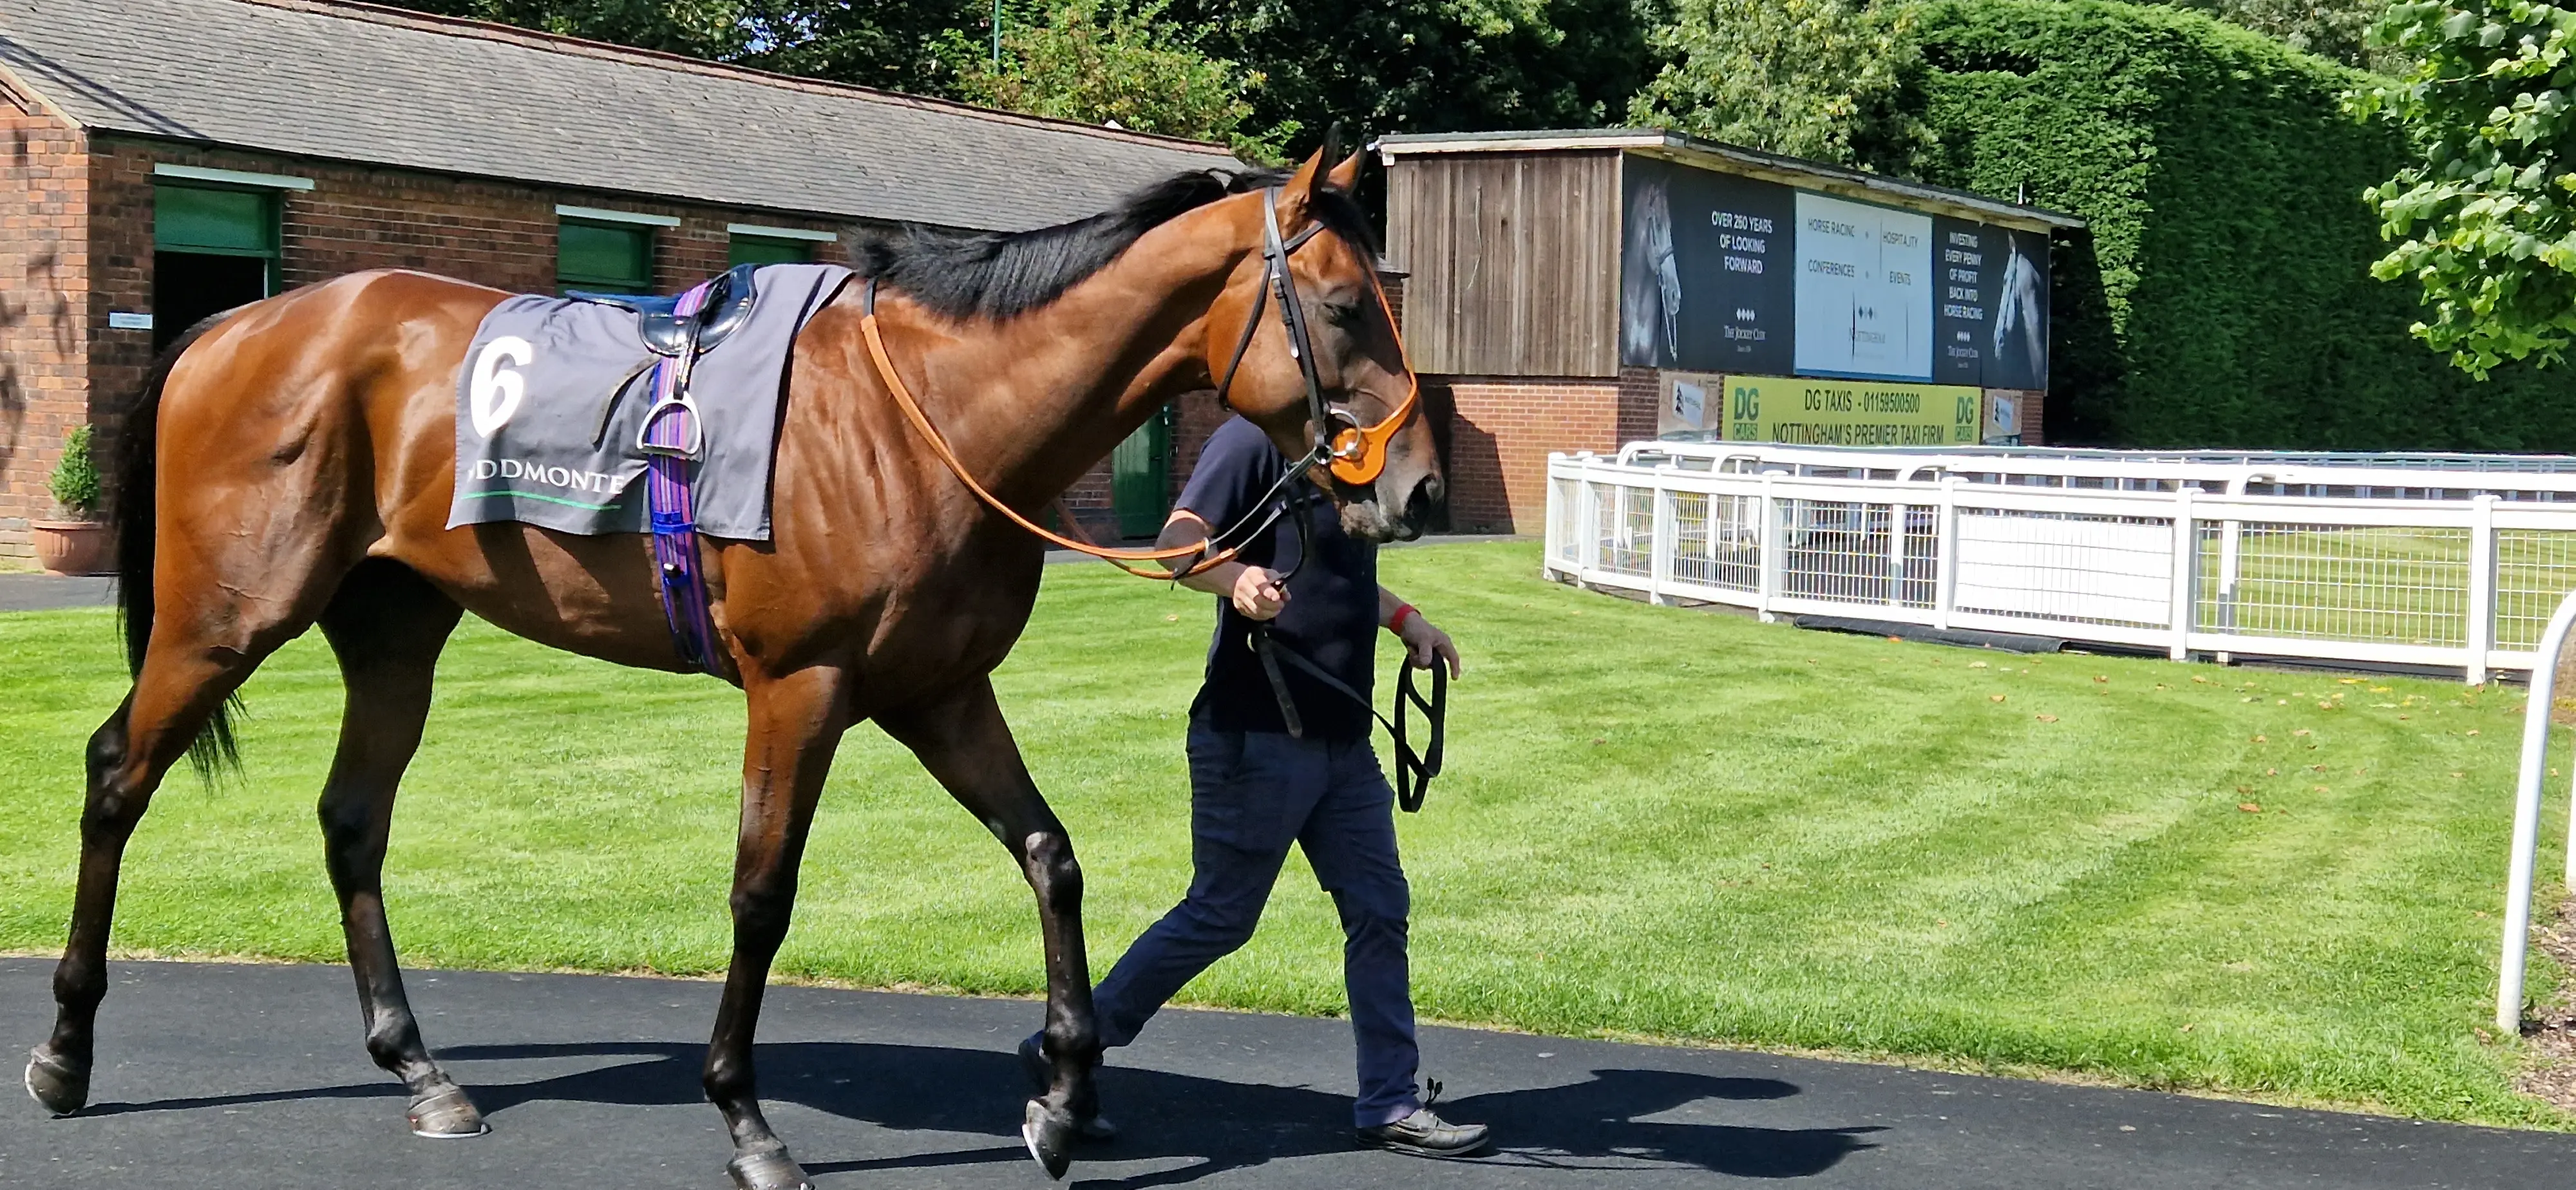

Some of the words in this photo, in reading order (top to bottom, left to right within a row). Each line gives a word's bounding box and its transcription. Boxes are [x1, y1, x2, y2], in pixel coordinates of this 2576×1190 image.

[1712, 211, 1732, 228] OVER
[1734, 214, 1748, 230] 260
[1749, 216, 1773, 234] YEARS
[1808, 218, 1830, 233] HORSE
[1719, 233, 1731, 249] OF
[1732, 236, 1765, 254] LOOKING
[1724, 256, 1763, 274] FORWARD
[1808, 259, 1855, 278] CONFERENCES
[1963, 252, 1982, 267] PENNY
[1889, 271, 1911, 285] EVENTS
[1949, 268, 1958, 281] OF
[470, 335, 532, 439] 6
[1734, 387, 1759, 421] DG
[1804, 389, 1821, 411] DG
[1824, 390, 1853, 412] TAXIS
[1864, 391, 1920, 413] 01159500500
[1956, 396, 1975, 425] DG
[1734, 424, 1757, 440] CARS
[1772, 422, 1852, 445] NOTTINGHAM'S
[1854, 424, 1898, 446] PREMIER
[1900, 425, 1920, 446] TAXI
[1922, 425, 1944, 444] FIRM
